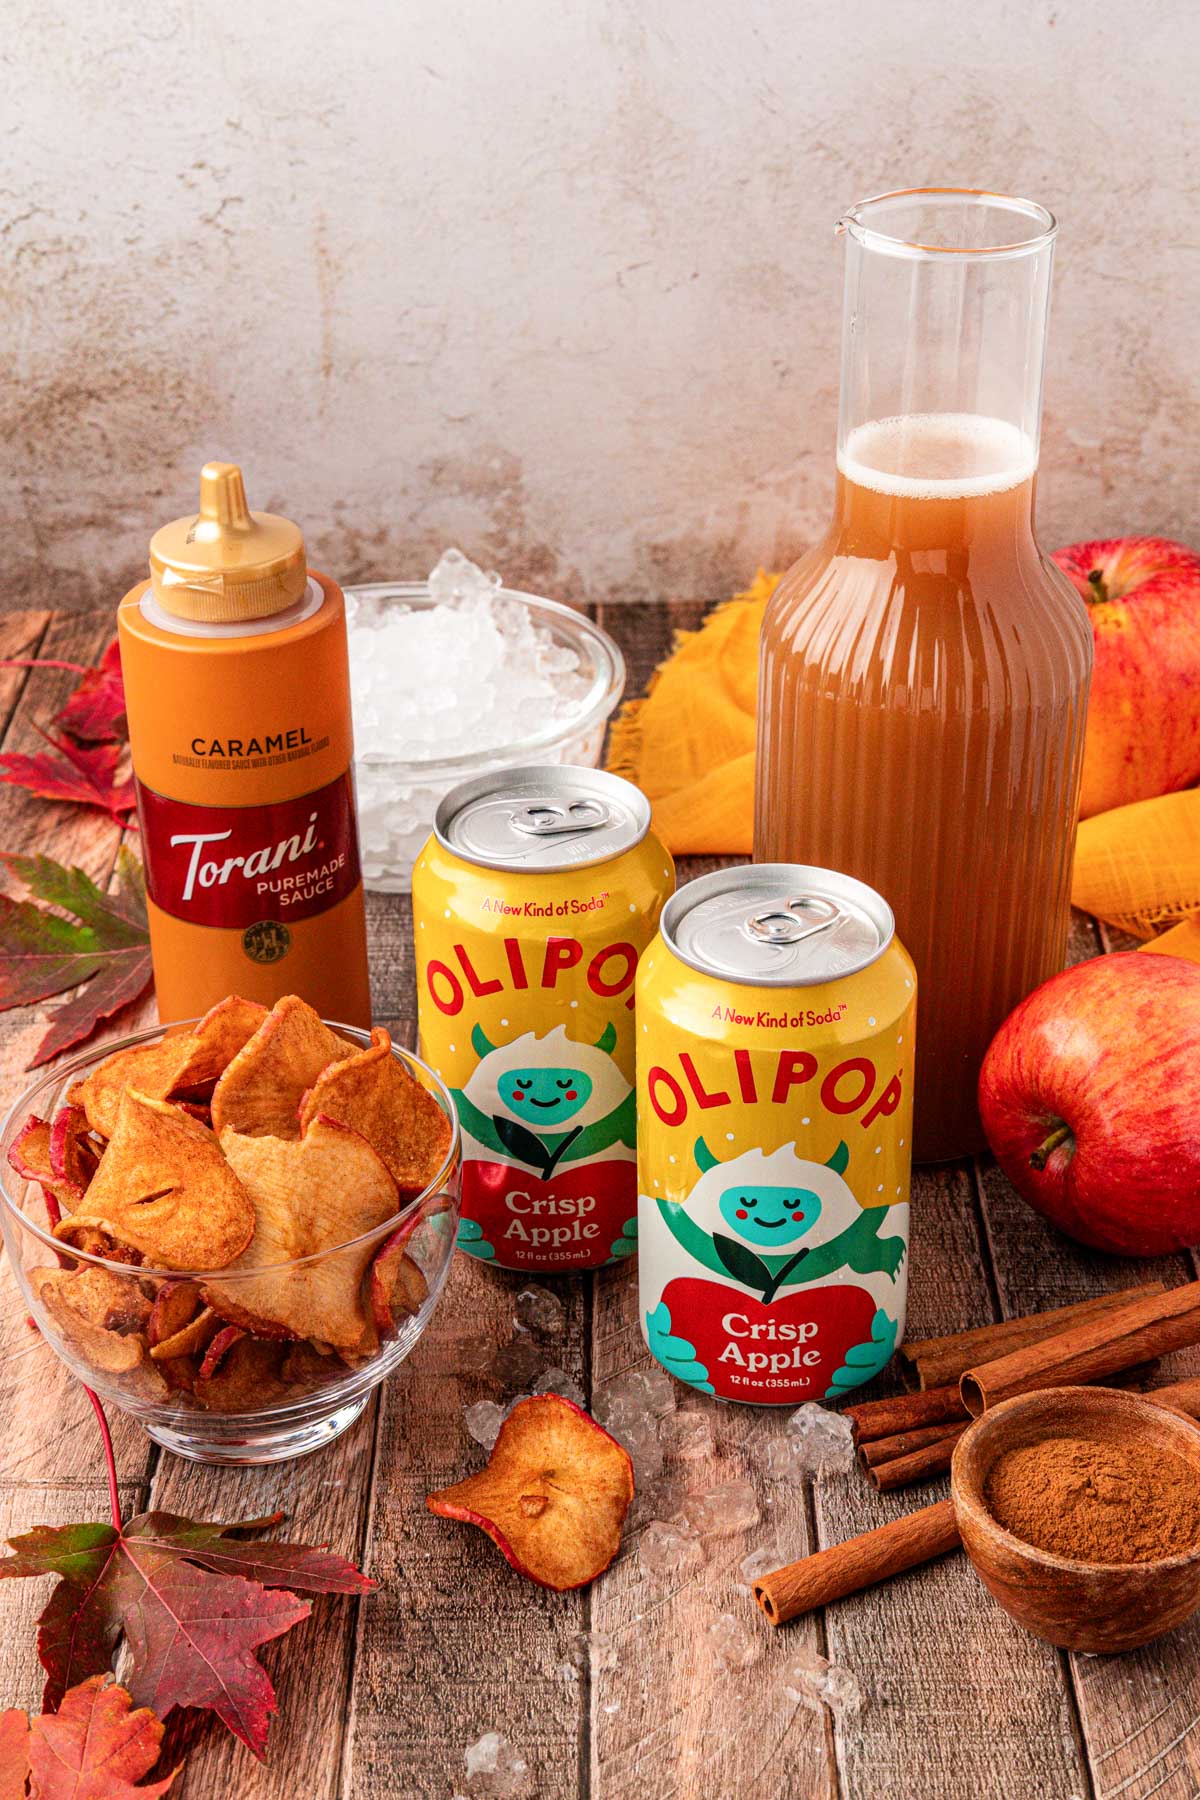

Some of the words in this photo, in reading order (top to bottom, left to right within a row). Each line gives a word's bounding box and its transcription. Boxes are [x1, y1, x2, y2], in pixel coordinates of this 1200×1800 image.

[191, 727, 312, 757] CARAMEL
[170, 811, 318, 900] Torani
[257, 853, 345, 895] PUREMADE
[280, 876, 334, 906] SAUCE
[481, 897, 491, 912] A
[494, 899, 522, 916] New
[524, 902, 553, 917] Kind
[556, 900, 568, 916] of
[427, 936, 638, 1016] OLIPO
[712, 1005, 721, 1020] A
[724, 1007, 754, 1026] New
[757, 1011, 787, 1028] Kind
[790, 1011, 803, 1027] of
[648, 1049, 902, 1129] OLIPOP
[505, 1190, 596, 1217] Crisp
[503, 1218, 601, 1247] Apple
[515, 1250, 526, 1259] 12
[527, 1251, 534, 1260] fl
[721, 1313, 819, 1344] Crisp
[718, 1342, 822, 1374] Apple
[730, 1375, 741, 1384] 12
[743, 1377, 750, 1385] fl
